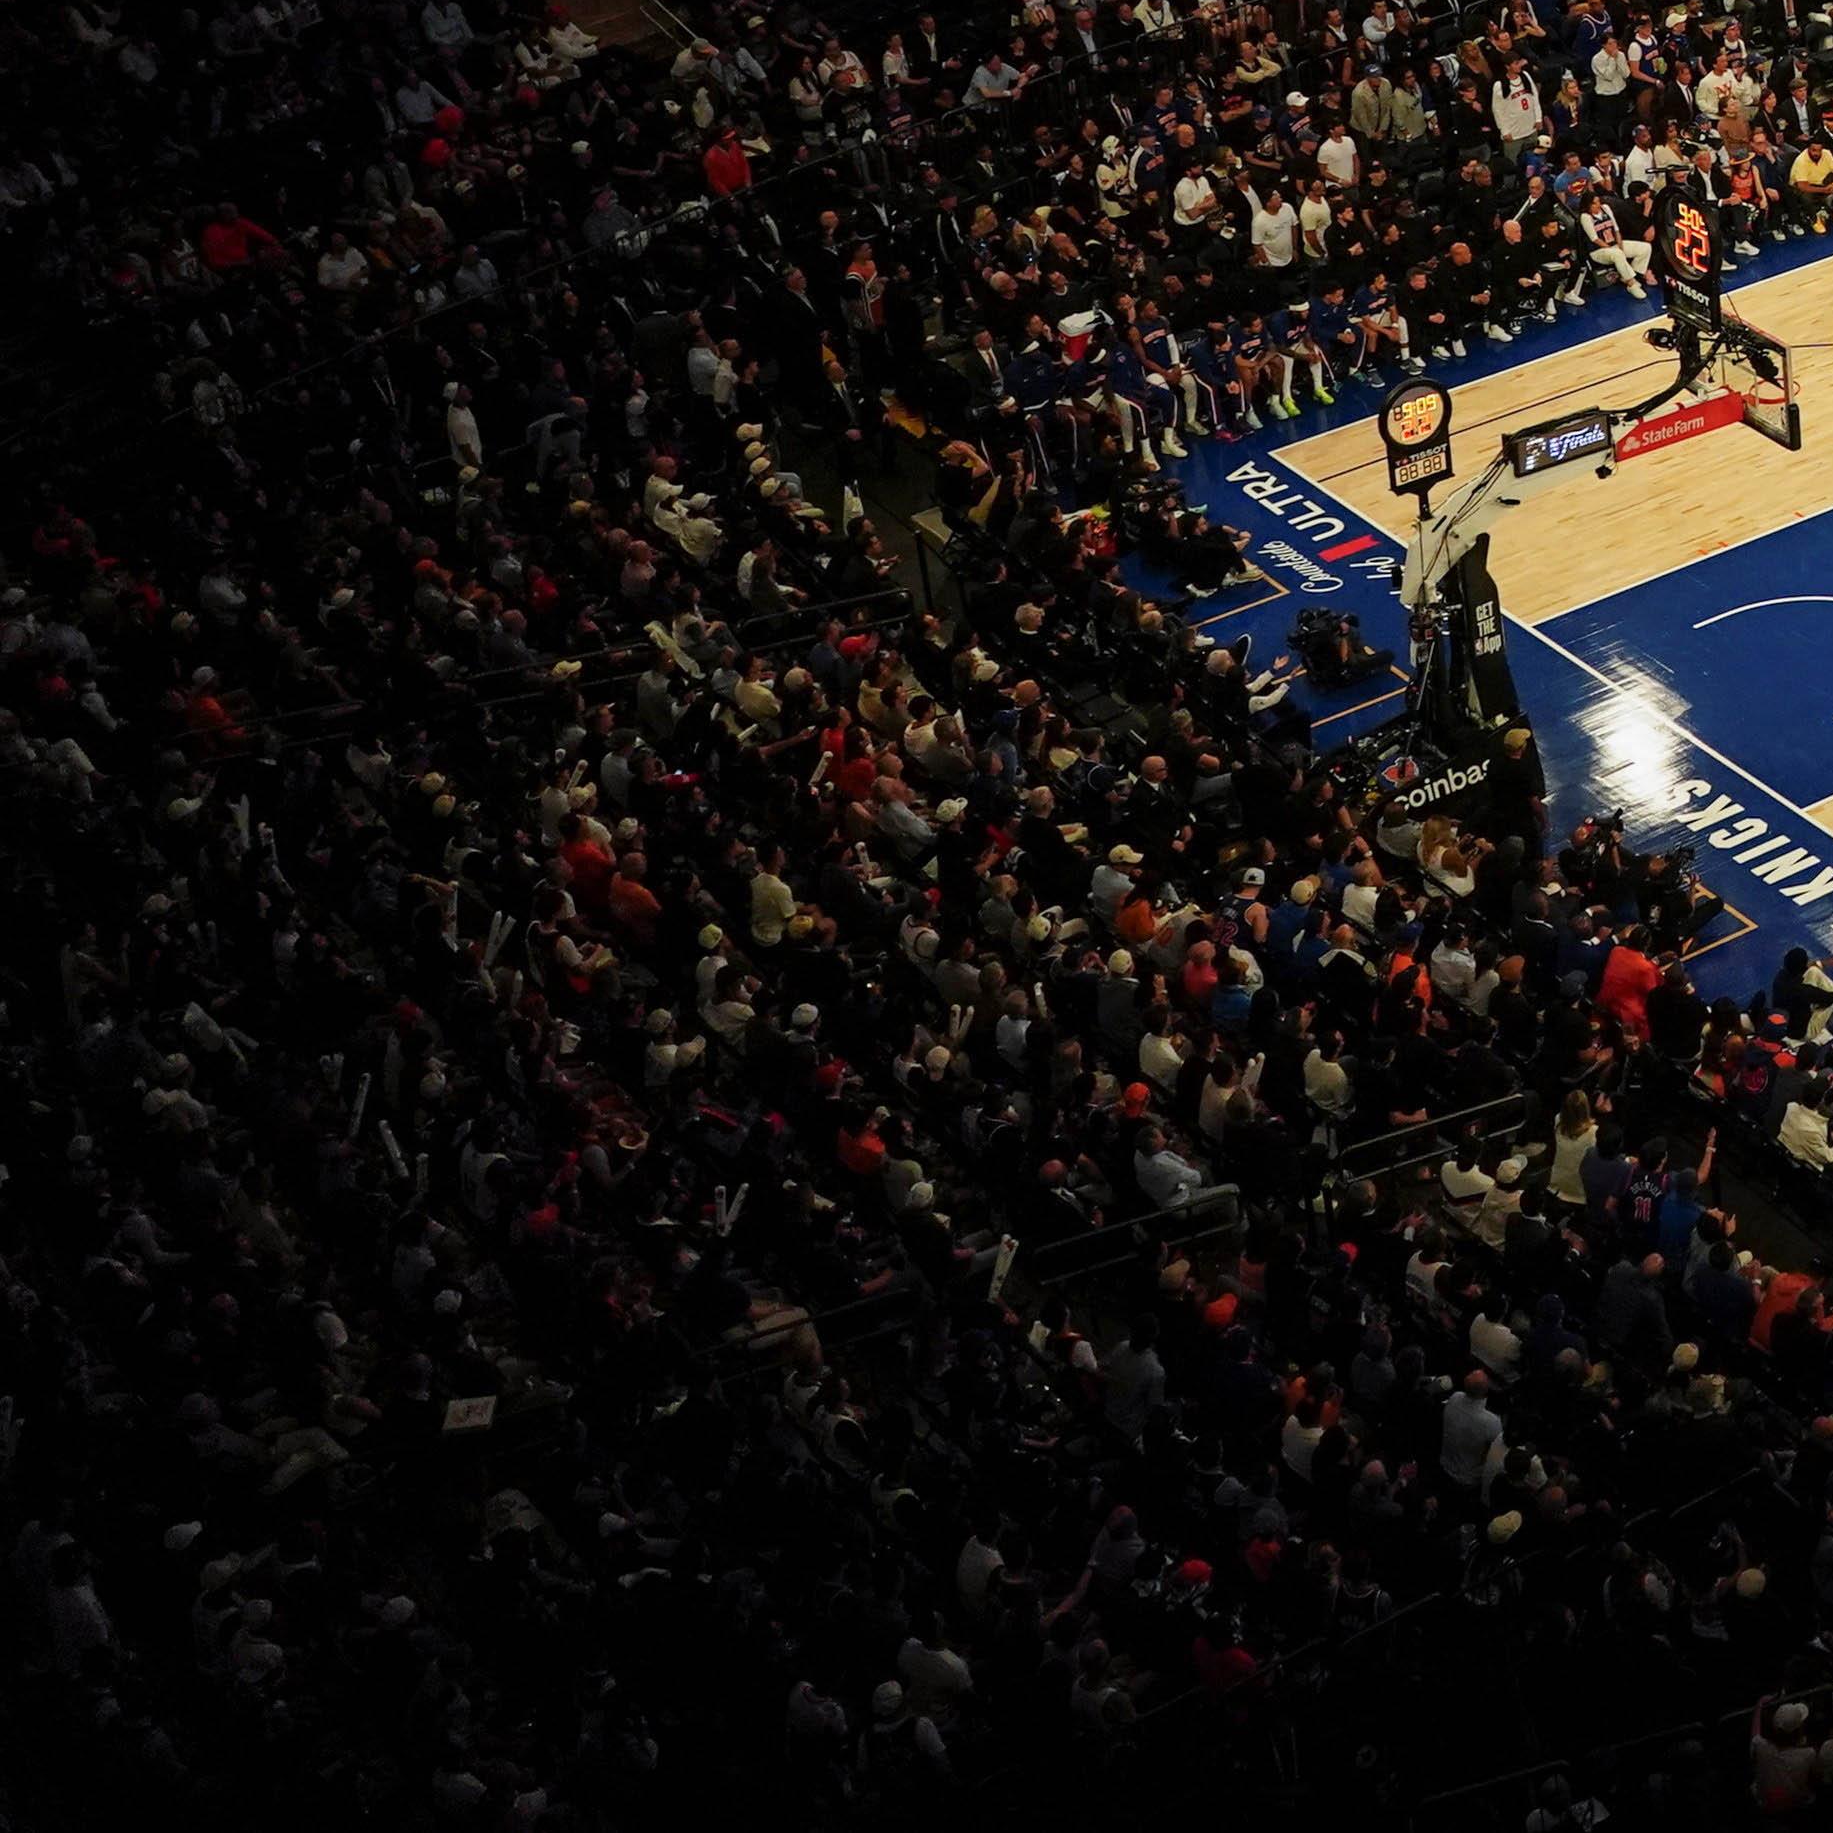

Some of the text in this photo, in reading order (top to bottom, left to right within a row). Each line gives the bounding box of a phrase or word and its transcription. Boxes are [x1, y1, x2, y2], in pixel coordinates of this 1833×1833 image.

[1673, 221, 1710, 274] 22
[1676, 280, 1711, 307] TISSOT
[1409, 443, 1448, 462] TISSOT
[1556, 425, 1607, 460] Finals
[1224, 460, 1345, 542] ULTRA
[1475, 600, 1494, 622] GET
[1476, 617, 1496, 637] THE
[1394, 758, 1491, 811] coinba
